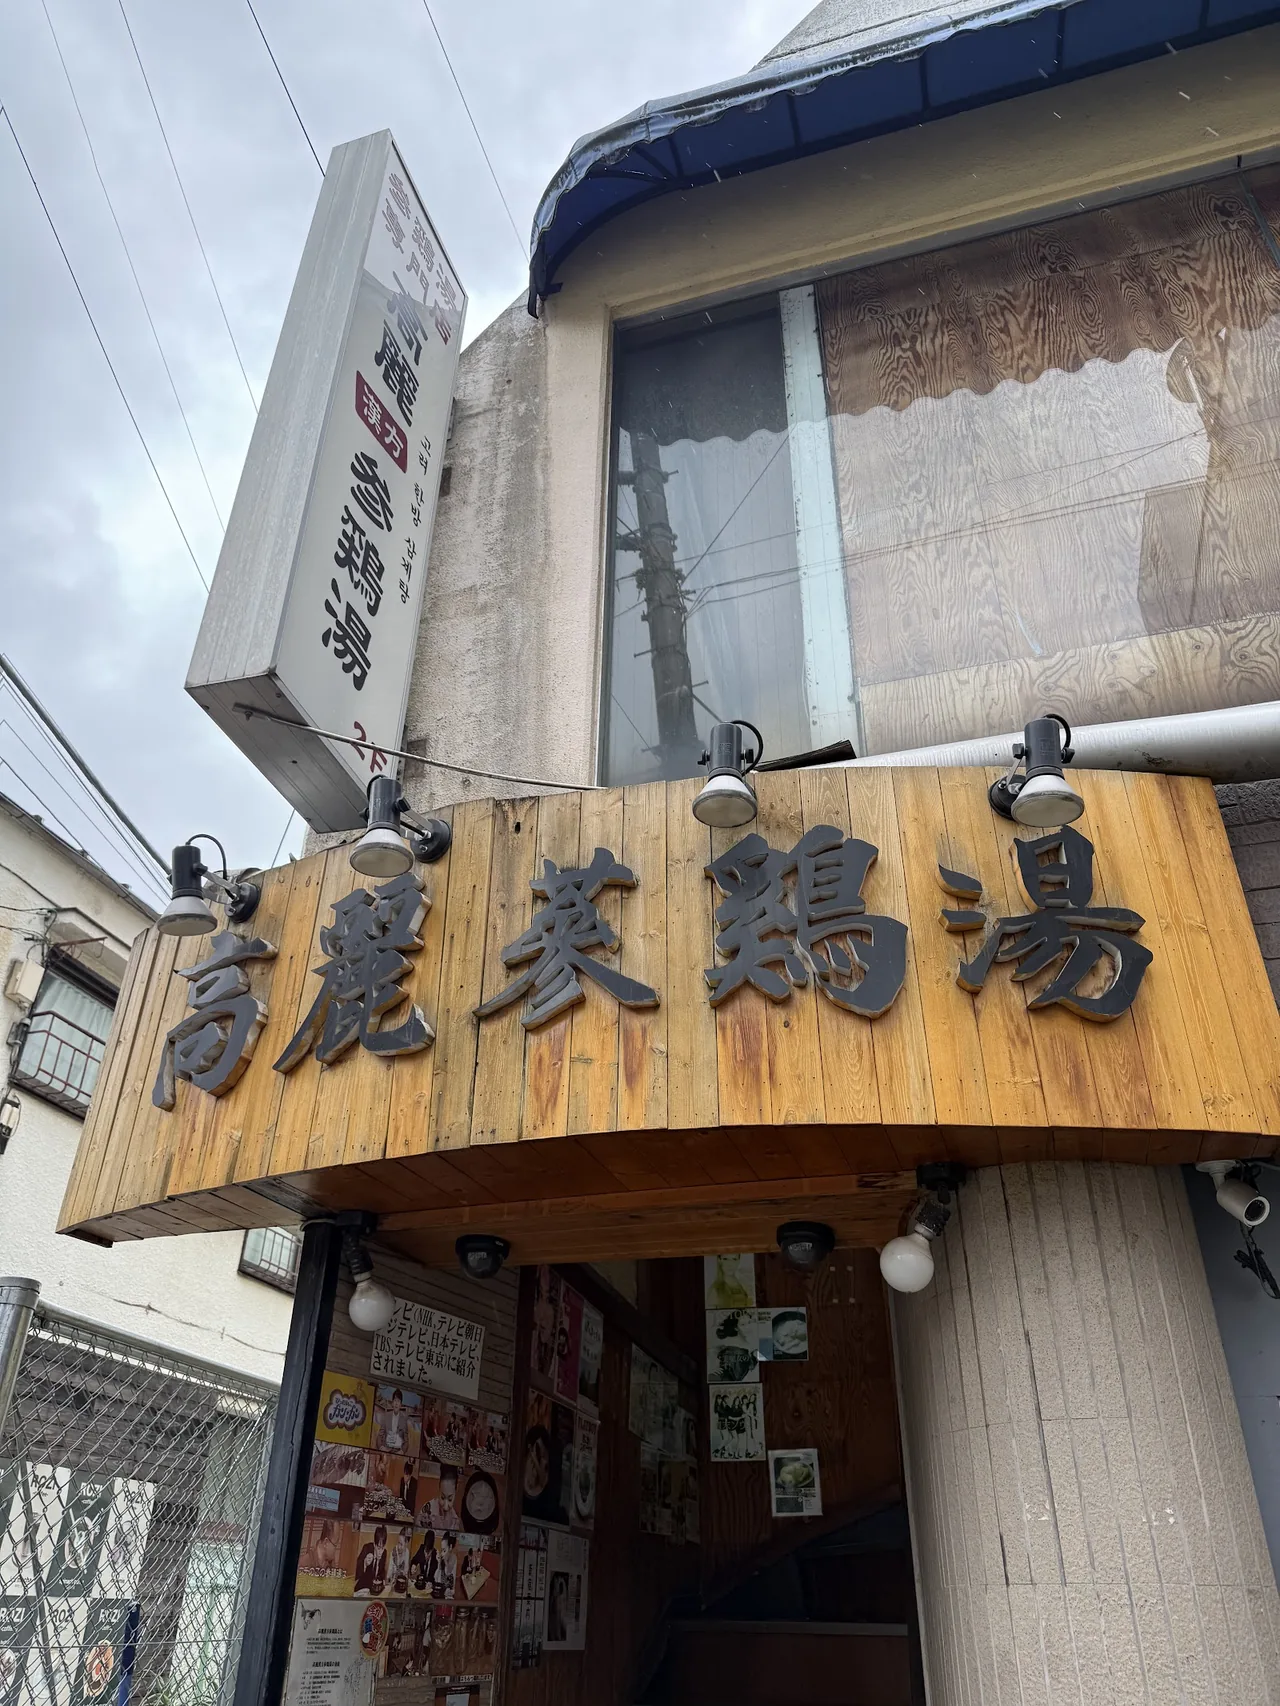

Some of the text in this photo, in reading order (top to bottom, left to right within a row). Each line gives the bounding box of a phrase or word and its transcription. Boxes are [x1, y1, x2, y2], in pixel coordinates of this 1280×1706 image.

[374, 270, 429, 428] 高麗
[363, 384, 404, 459] 漢方
[398, 435, 432, 604] 고려 한방 삼계탕
[350, 721, 388, 773] 2F
[372, 1352, 433, 1386] されました。
[386, 1317, 480, 1362] ジテレビ、日本テレビ、
